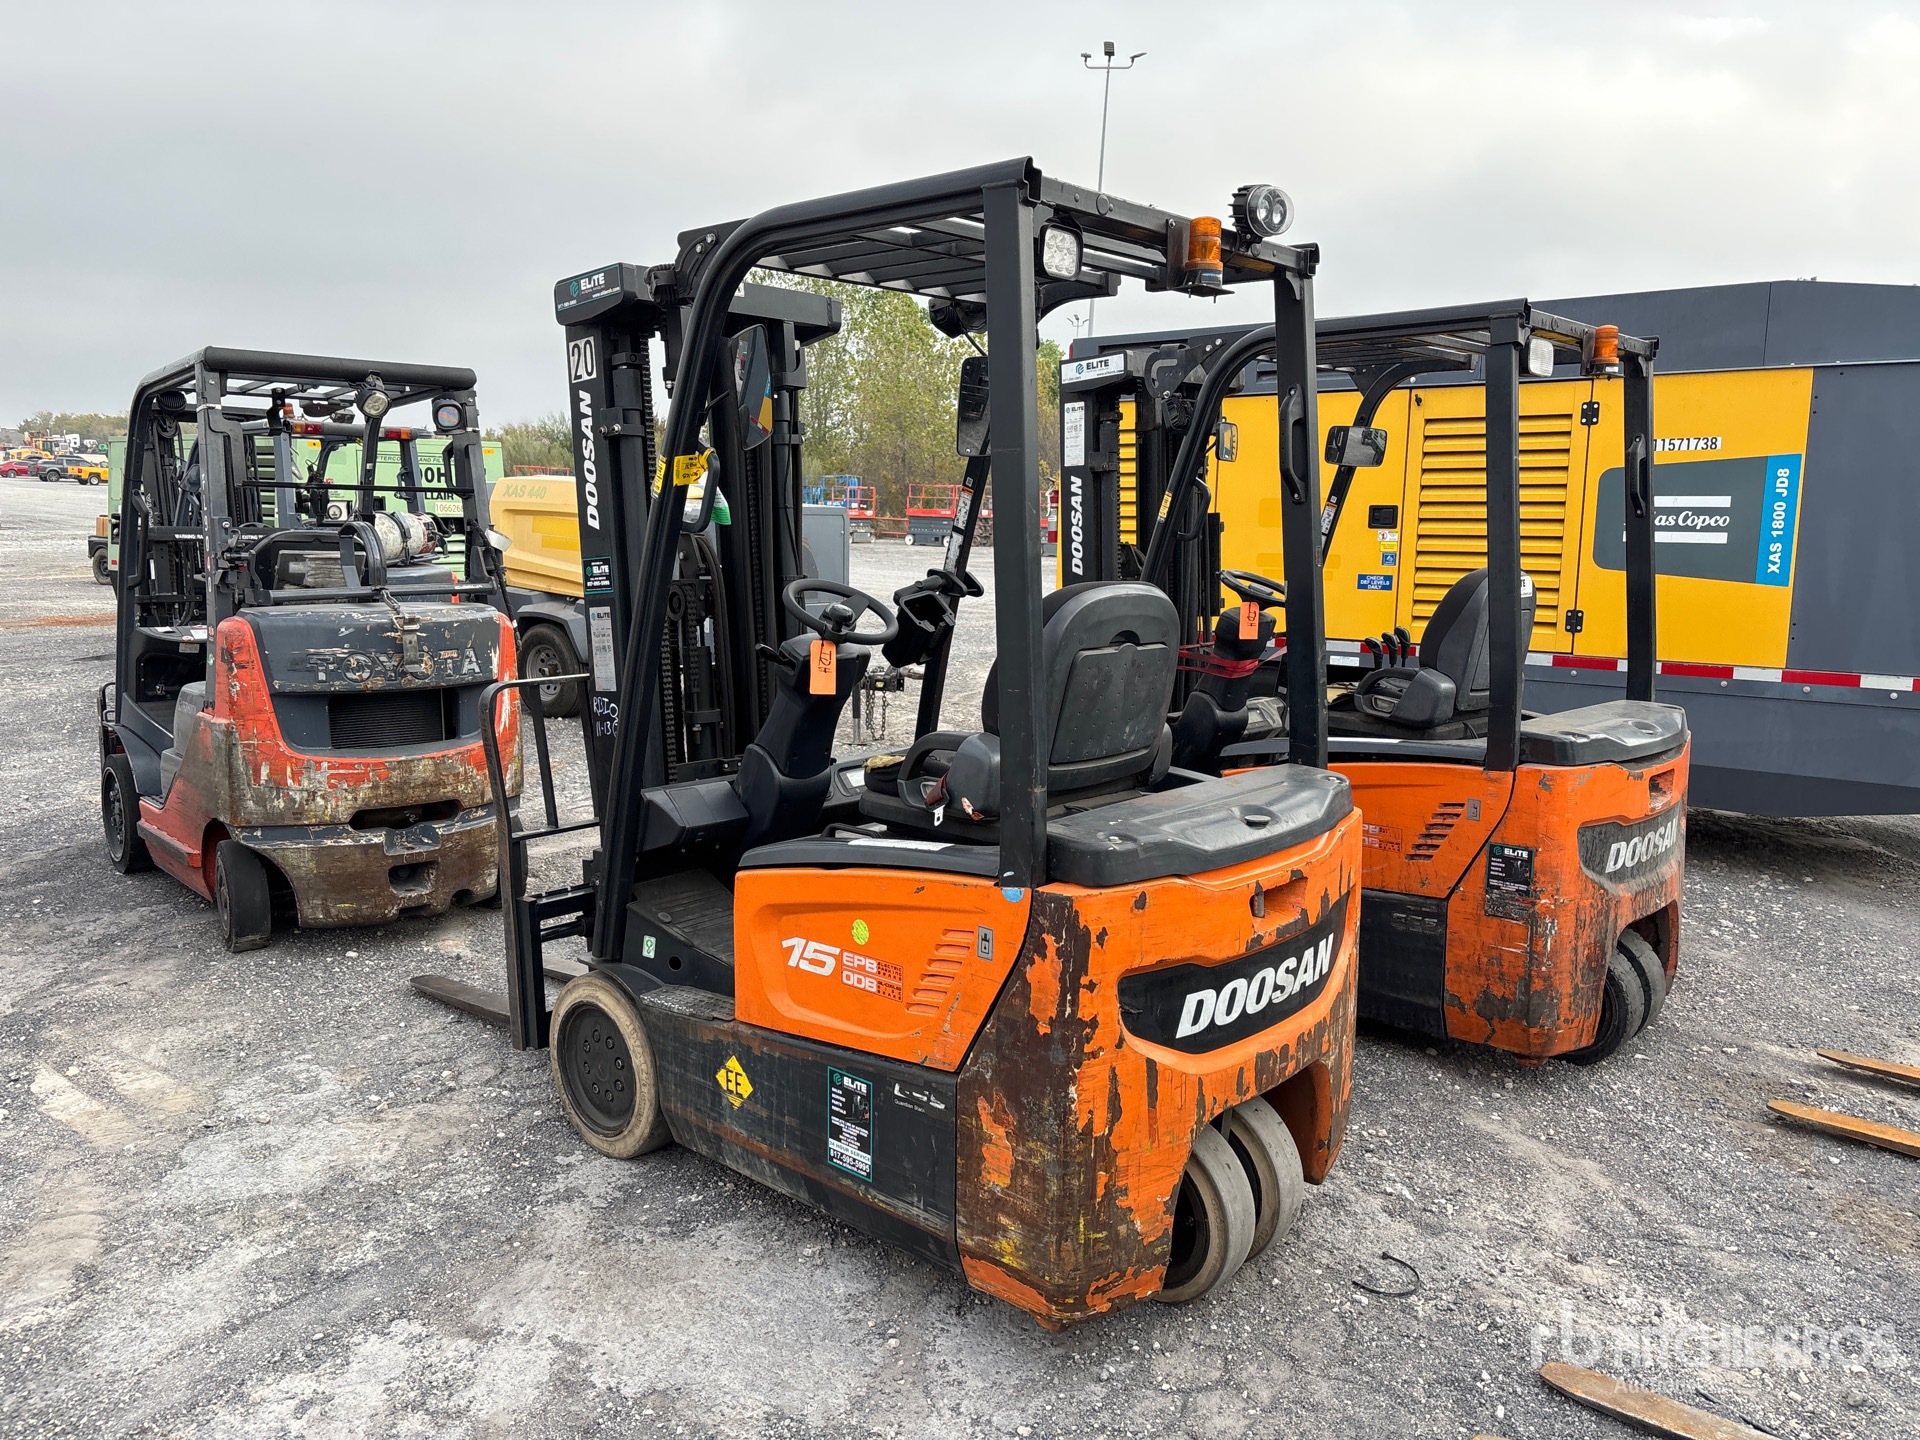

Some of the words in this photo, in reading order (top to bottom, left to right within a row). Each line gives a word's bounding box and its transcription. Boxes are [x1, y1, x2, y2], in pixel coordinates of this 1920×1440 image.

[581, 273, 605, 290] ELITE
[571, 339, 595, 381] 20
[1086, 359, 1110, 370] ELITE
[579, 390, 600, 530] DOOSAN
[503, 484, 526, 497] XAS
[528, 486, 547, 499] 440
[1775, 468, 1790, 497] JD8
[1071, 475, 1083, 576] DOOSAN
[1678, 511, 1730, 530] Copco
[1771, 501, 1787, 538] 1800
[592, 565, 609, 573] ELITE
[1767, 542, 1783, 574] XAS
[1504, 848, 1529, 858] ELITE
[1605, 815, 1679, 873] DOOSAN
[781, 937, 841, 976] 15
[843, 951, 877, 973] EPB
[842, 970, 877, 992] ODB
[1176, 932, 1334, 1039] DOOSAN
[726, 1070, 743, 1098] EE
[844, 1076, 867, 1093] ELITE
[830, 1148, 870, 1173] 817-595-5995
[836, 1143, 849, 1154] HOUR
[851, 1148, 870, 1162] SERVICE
